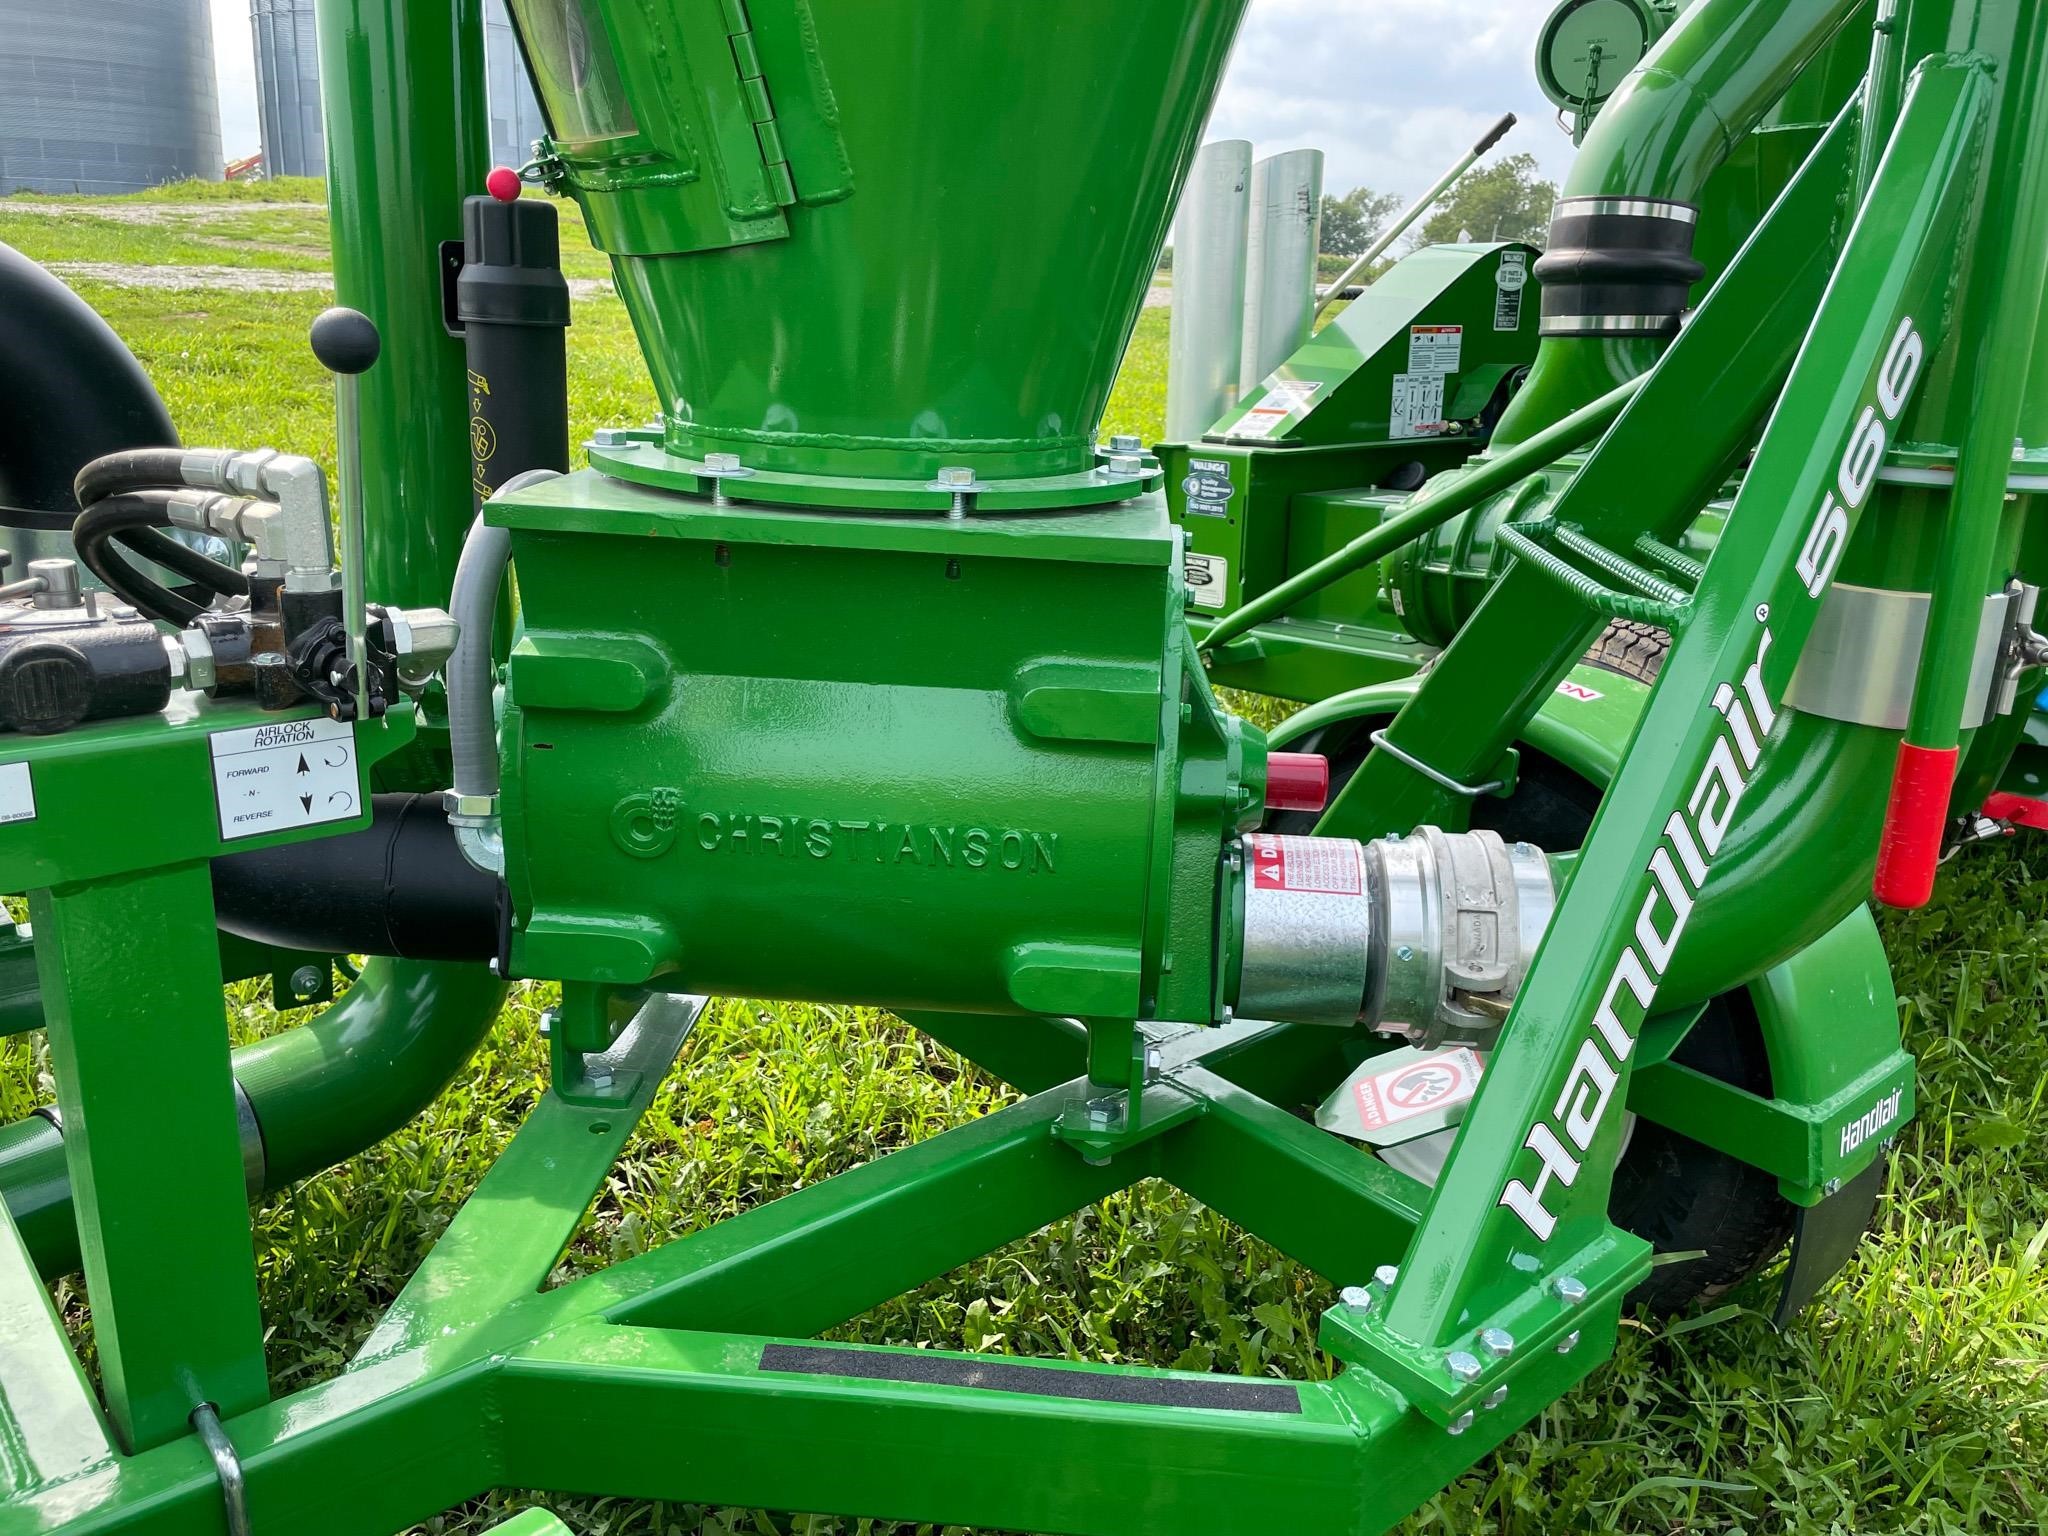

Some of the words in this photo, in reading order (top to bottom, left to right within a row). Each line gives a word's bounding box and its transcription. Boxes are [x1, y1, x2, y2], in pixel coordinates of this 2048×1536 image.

[1795, 316, 1925, 599] 566
[254, 730, 315, 748] ROTATION
[256, 721, 311, 738] AIRLOCK
[226, 765, 270, 778] FORWARD
[233, 809, 273, 823] REVERSE
[697, 811, 1059, 873] CHRISTIANSON
[1360, 1080, 1381, 1120] DANGER
[1840, 1086, 1903, 1158] Handlair
